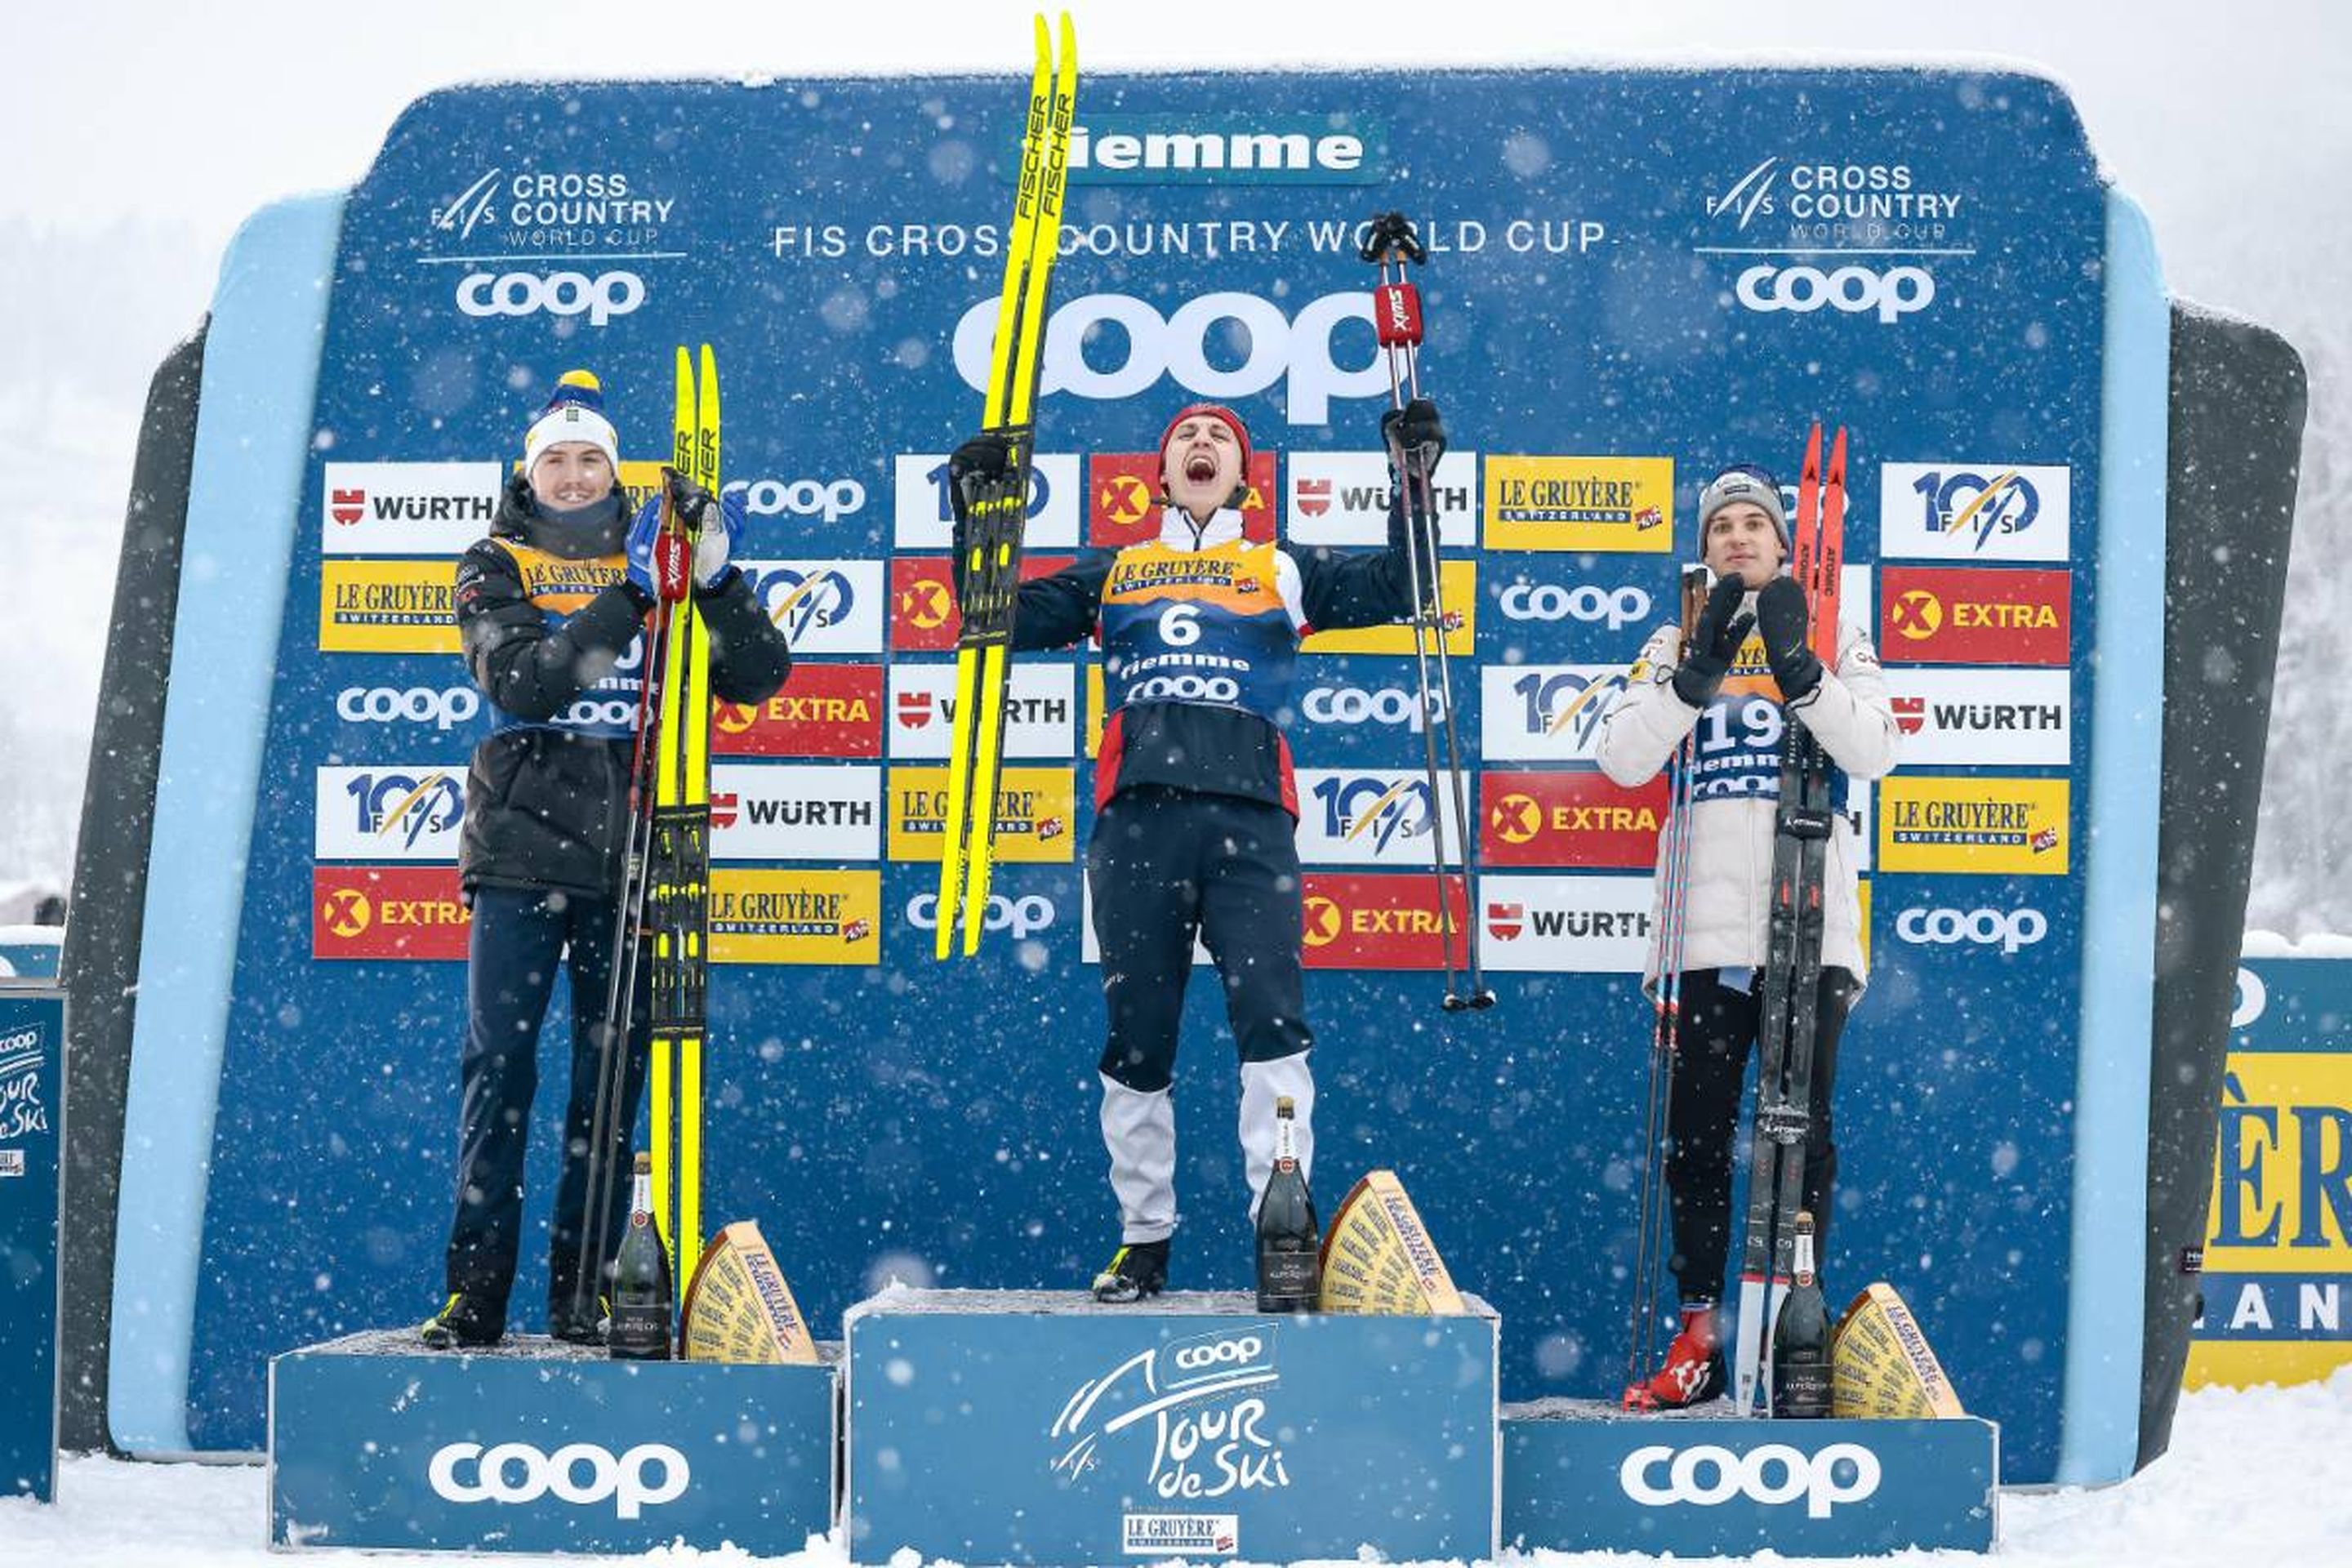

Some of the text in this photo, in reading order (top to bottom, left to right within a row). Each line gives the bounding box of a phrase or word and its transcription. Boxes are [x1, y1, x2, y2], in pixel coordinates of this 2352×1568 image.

[1018, 94, 1047, 220] FISCHER
[1023, 126, 1364, 170] iemme
[1042, 92, 1072, 218] FISCHER
[512, 173, 627, 198] CROSS
[1790, 165, 1912, 190] CROSS
[510, 198, 675, 226] COUNTRY
[1790, 193, 1962, 219] COUNTRY
[509, 228, 658, 247] WORLD CUP
[774, 225, 847, 258] FIS
[866, 224, 1010, 257] CROS
[1308, 220, 1487, 253] WOLD
[1506, 220, 1604, 252] CUP
[1790, 222, 1882, 239] WORD
[456, 271, 645, 326] coop
[1736, 266, 1936, 324] coop
[1341, 487, 1468, 512] WÜH
[1499, 475, 1633, 508] LE GRUYÈRE
[373, 496, 493, 521] WÜRTH
[335, 583, 360, 609] LE
[1499, 585, 1651, 630] coop
[1158, 604, 1201, 647] 6
[1953, 602, 2059, 629] EXTRA
[336, 686, 479, 730] coop
[767, 697, 871, 723] EXTRA
[940, 699, 1066, 724] WRTH
[1302, 688, 1447, 733] coop
[1934, 705, 2062, 730] WÜRTH
[1701, 699, 1783, 753] 19
[747, 800, 871, 826] WÜRTH
[903, 791, 931, 817] LE
[1552, 806, 1658, 832] EXTRA
[1894, 800, 1920, 828] LE
[1926, 797, 2029, 830] GRUYÈRE
[710, 889, 841, 920] LE GRUYÈRE
[906, 893, 1056, 940] cop
[1351, 909, 1458, 934] EXTRA
[1895, 907, 2048, 953] coop
[1175, 1336, 1262, 1370] coop
[429, 1442, 690, 1520] coop
[1157, 1463, 1202, 1499] de
[1620, 1442, 1881, 1519] coop
[1127, 1516, 1215, 1538] LE GRUYÈRE
